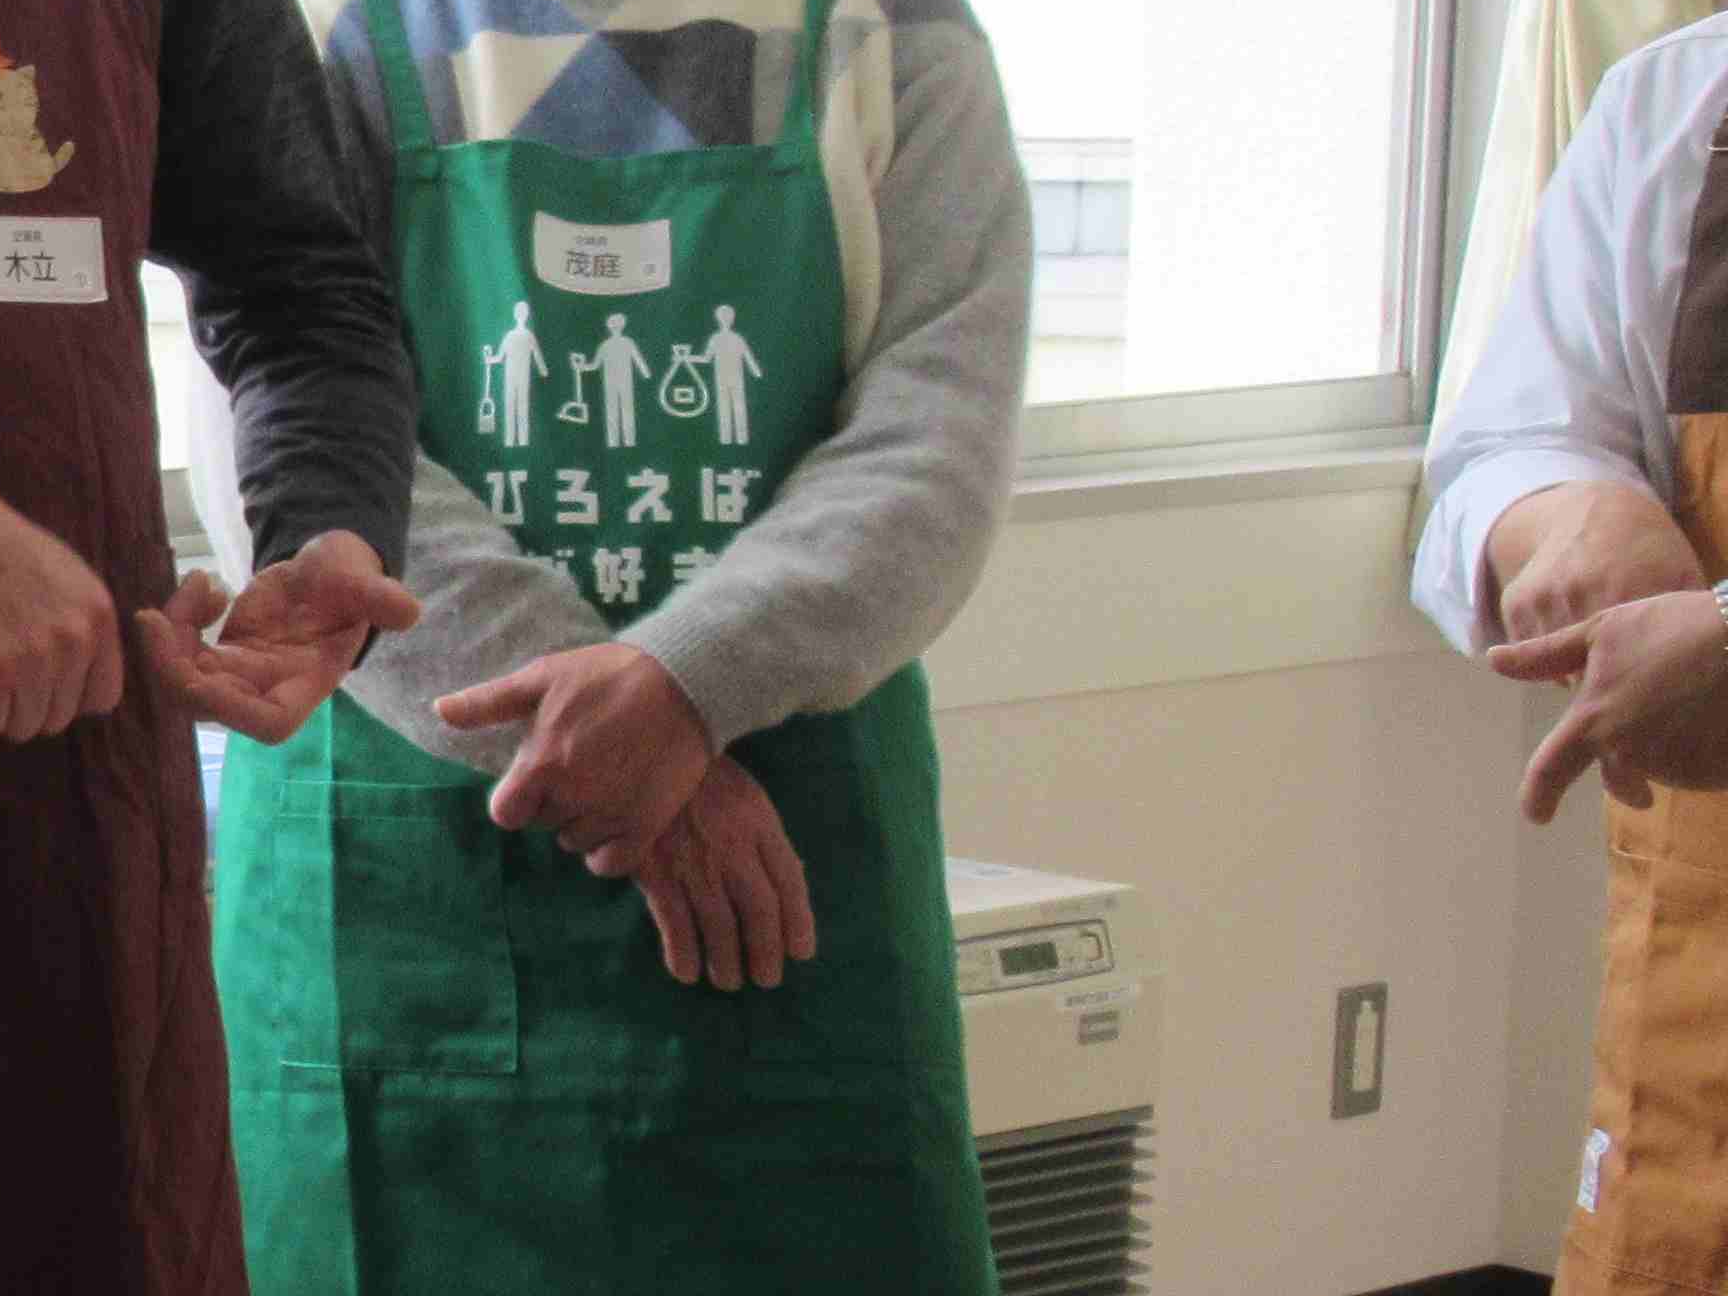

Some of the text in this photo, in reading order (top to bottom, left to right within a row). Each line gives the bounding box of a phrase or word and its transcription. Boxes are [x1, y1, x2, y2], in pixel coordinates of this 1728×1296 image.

[4, 250, 57, 284] 木立
[484, 467, 762, 525] ひろえば
